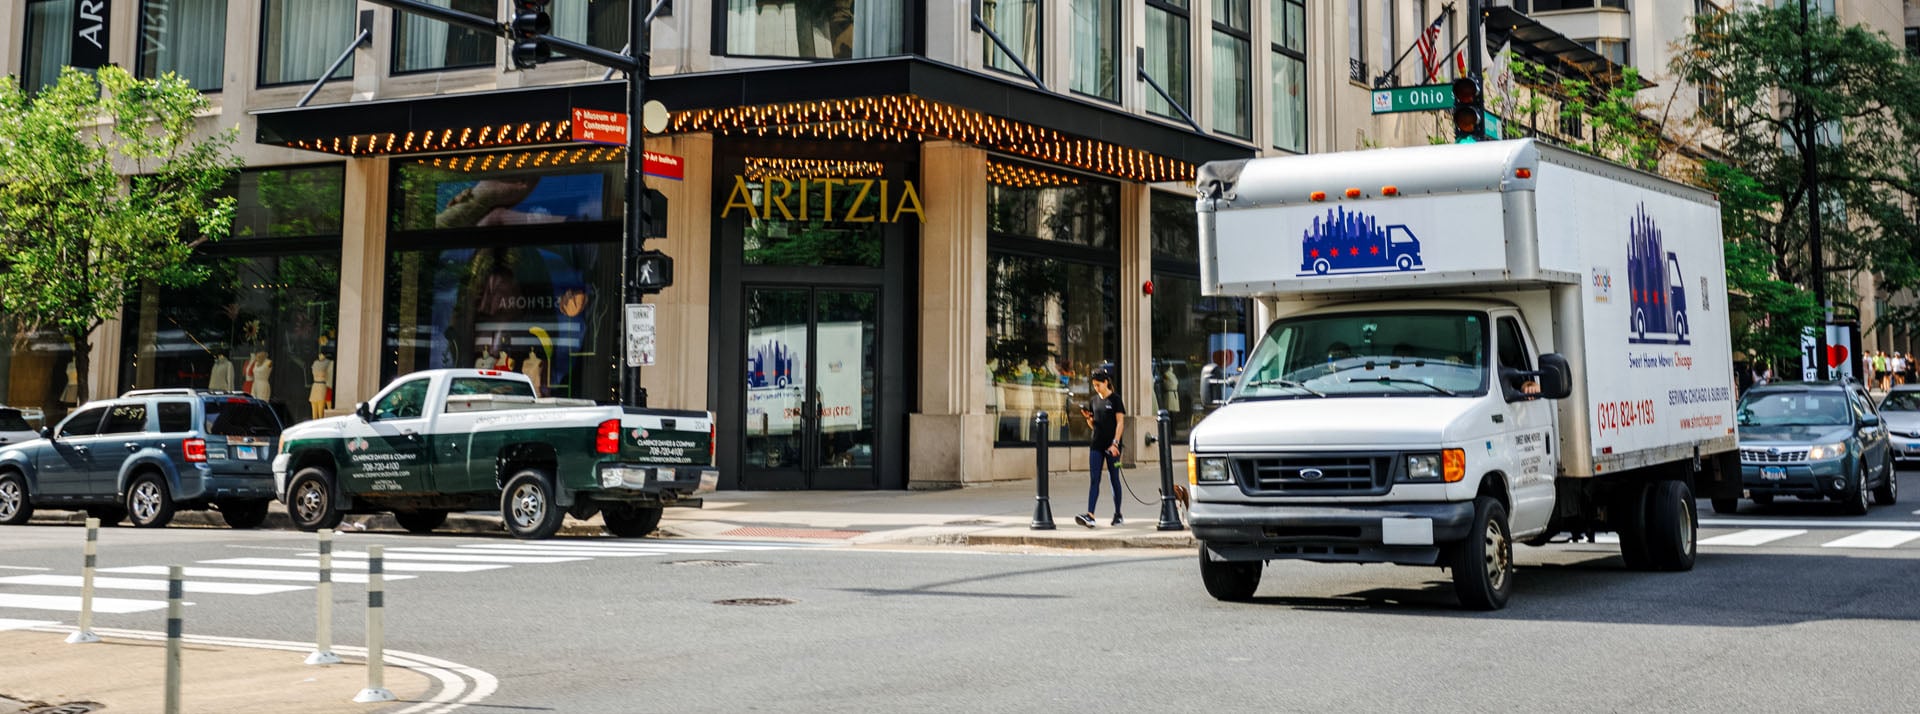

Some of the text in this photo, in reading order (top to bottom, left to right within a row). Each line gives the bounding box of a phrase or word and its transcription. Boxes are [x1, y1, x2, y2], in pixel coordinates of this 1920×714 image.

[1410, 90, 1444, 106] Ohio
[583, 110, 617, 122] Museum of
[583, 120, 625, 135] Contemporary
[583, 130, 594, 139] Art
[650, 153, 678, 166] Art Institute
[721, 175, 927, 224] ARITZIA
[1592, 266, 1611, 293] Google
[1629, 352, 1642, 368] Sweet
[1643, 352, 1657, 368] Home
[1674, 351, 1692, 370] Chicago
[1668, 389, 1688, 406] SERVING
[1689, 388, 1707, 404] CHICAGO
[1597, 400, 1655, 437] (312) 824-1193
[394, 453, 416, 461] COMPANY
